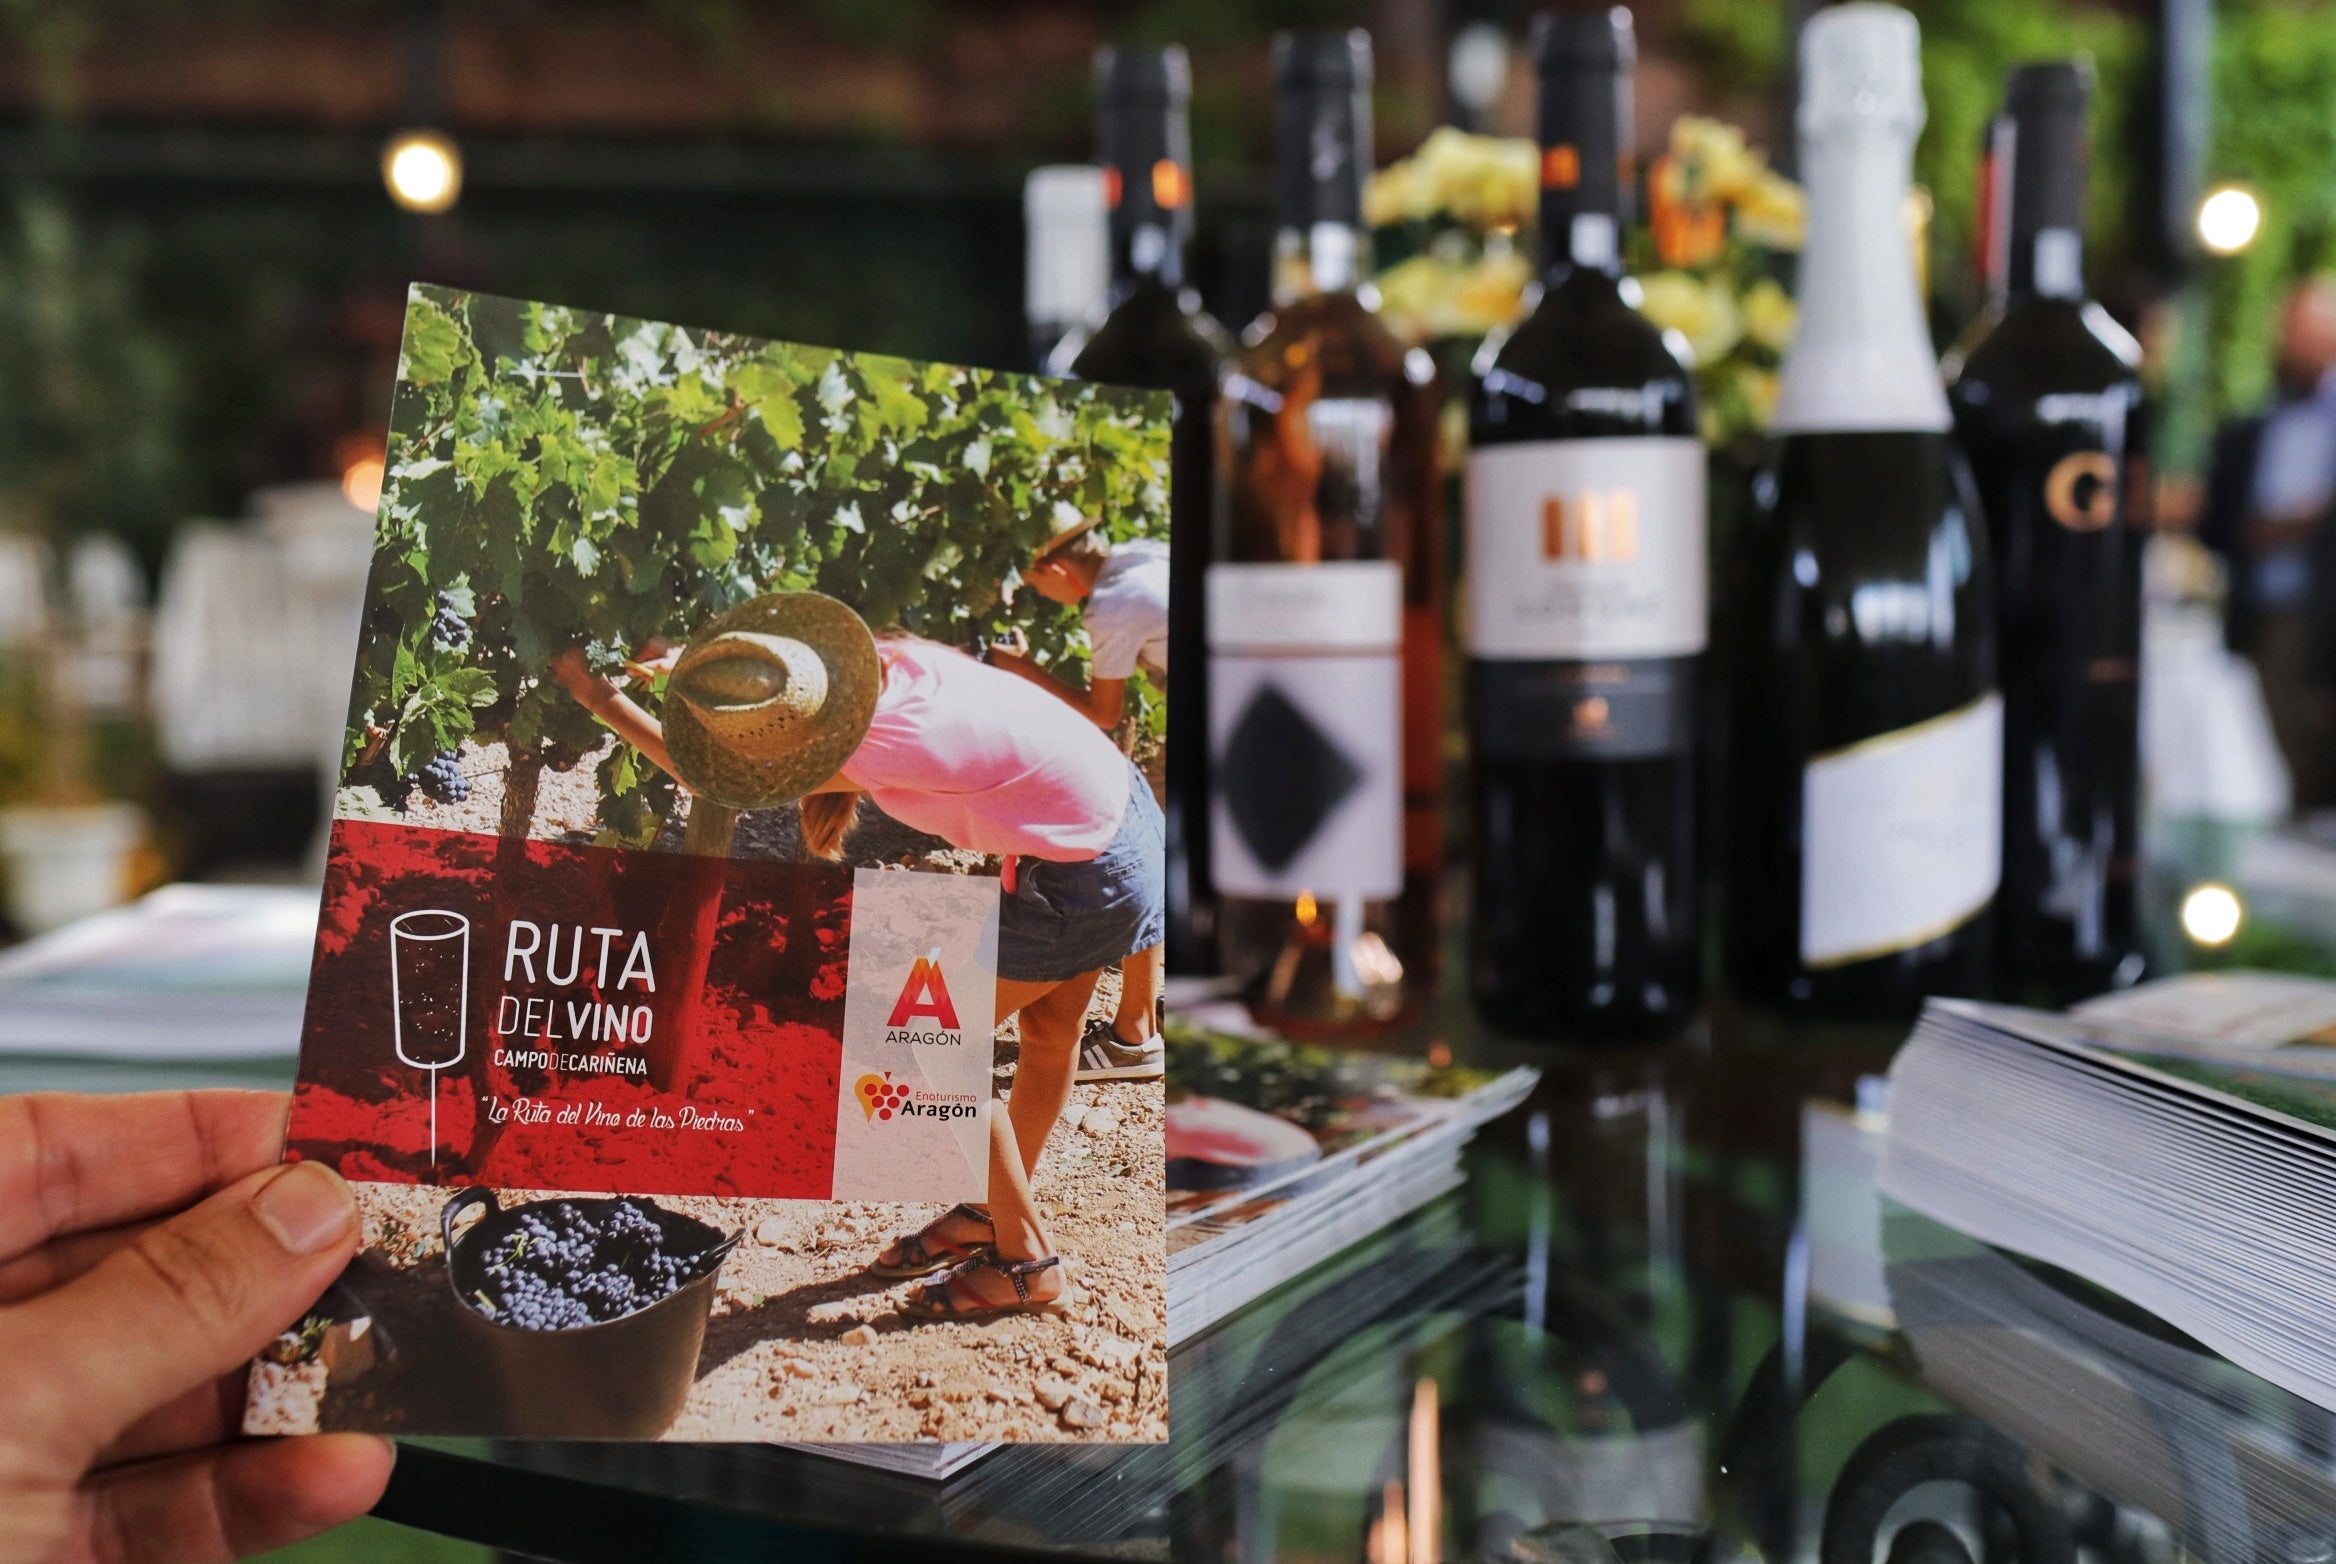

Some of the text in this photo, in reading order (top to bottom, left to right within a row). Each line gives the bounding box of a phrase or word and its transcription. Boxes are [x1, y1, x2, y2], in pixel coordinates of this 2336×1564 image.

[504, 919, 657, 993] RUTA
[885, 1030, 962, 1046] ARAGÓN
[915, 1091, 977, 1102] Enoturismo
[512, 1097, 551, 1125] Ruta
[556, 1102, 583, 1125] del
[584, 1101, 621, 1126] Vino
[626, 1107, 647, 1128] de
[650, 1106, 675, 1129] las
[900, 1100, 977, 1121] Aragón
